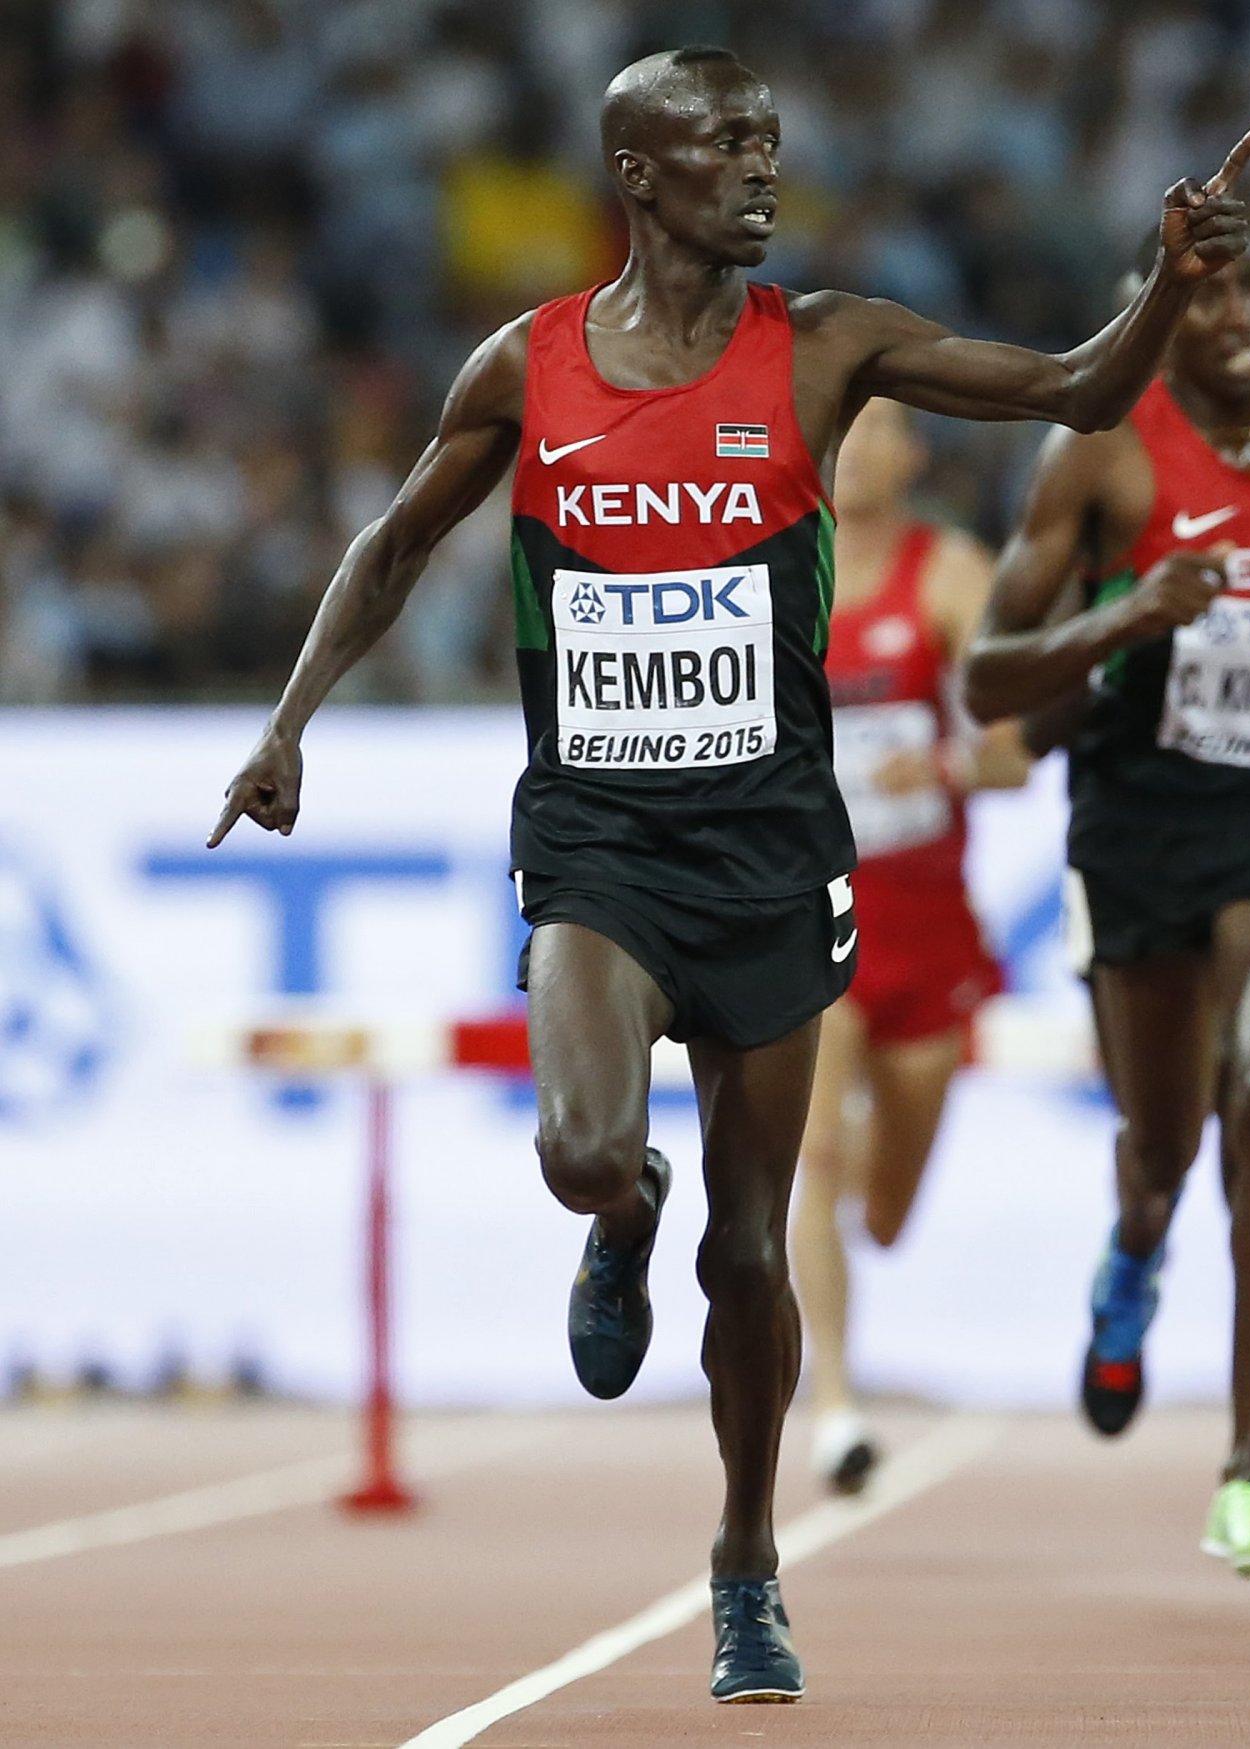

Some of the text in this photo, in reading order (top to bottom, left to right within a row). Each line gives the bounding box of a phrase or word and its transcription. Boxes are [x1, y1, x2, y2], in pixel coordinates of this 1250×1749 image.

[556, 482, 763, 527] KENYA
[604, 576, 751, 625] TDK
[567, 644, 757, 711] KEMBOI
[568, 725, 763, 764] BEIJING 2015
